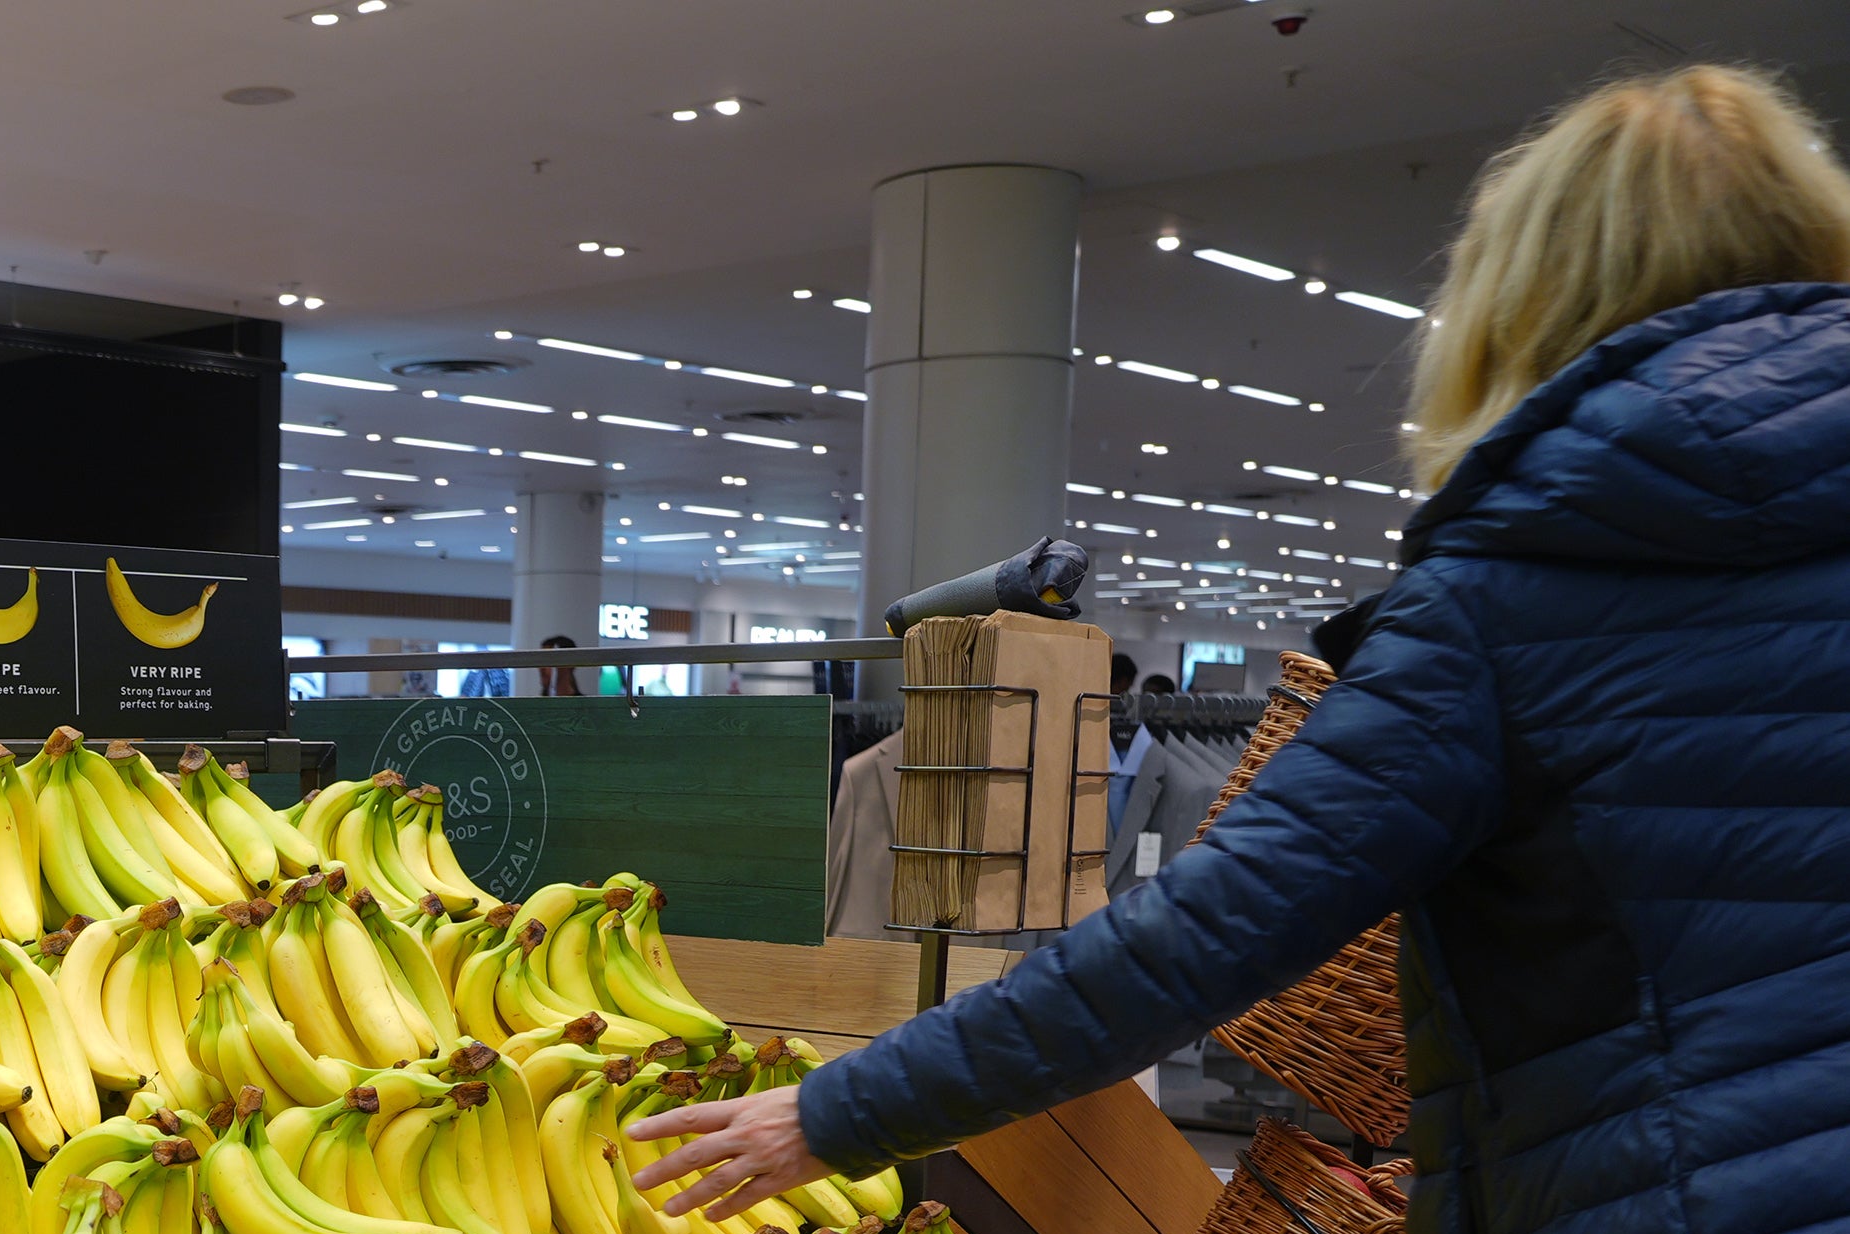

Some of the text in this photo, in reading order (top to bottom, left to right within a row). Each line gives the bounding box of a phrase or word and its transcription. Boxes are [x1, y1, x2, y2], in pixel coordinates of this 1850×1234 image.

[130, 666, 201, 679] VERY RIPE
[18, 684, 60, 696] flavour.
[120, 686, 211, 700] Strong flavour and
[120, 699, 212, 713] perfect for baking.
[397, 706, 529, 782] GREAT FOOD
[448, 776, 492, 814] &S
[446, 826, 478, 842] OOD
[490, 836, 534, 900] SEAL
